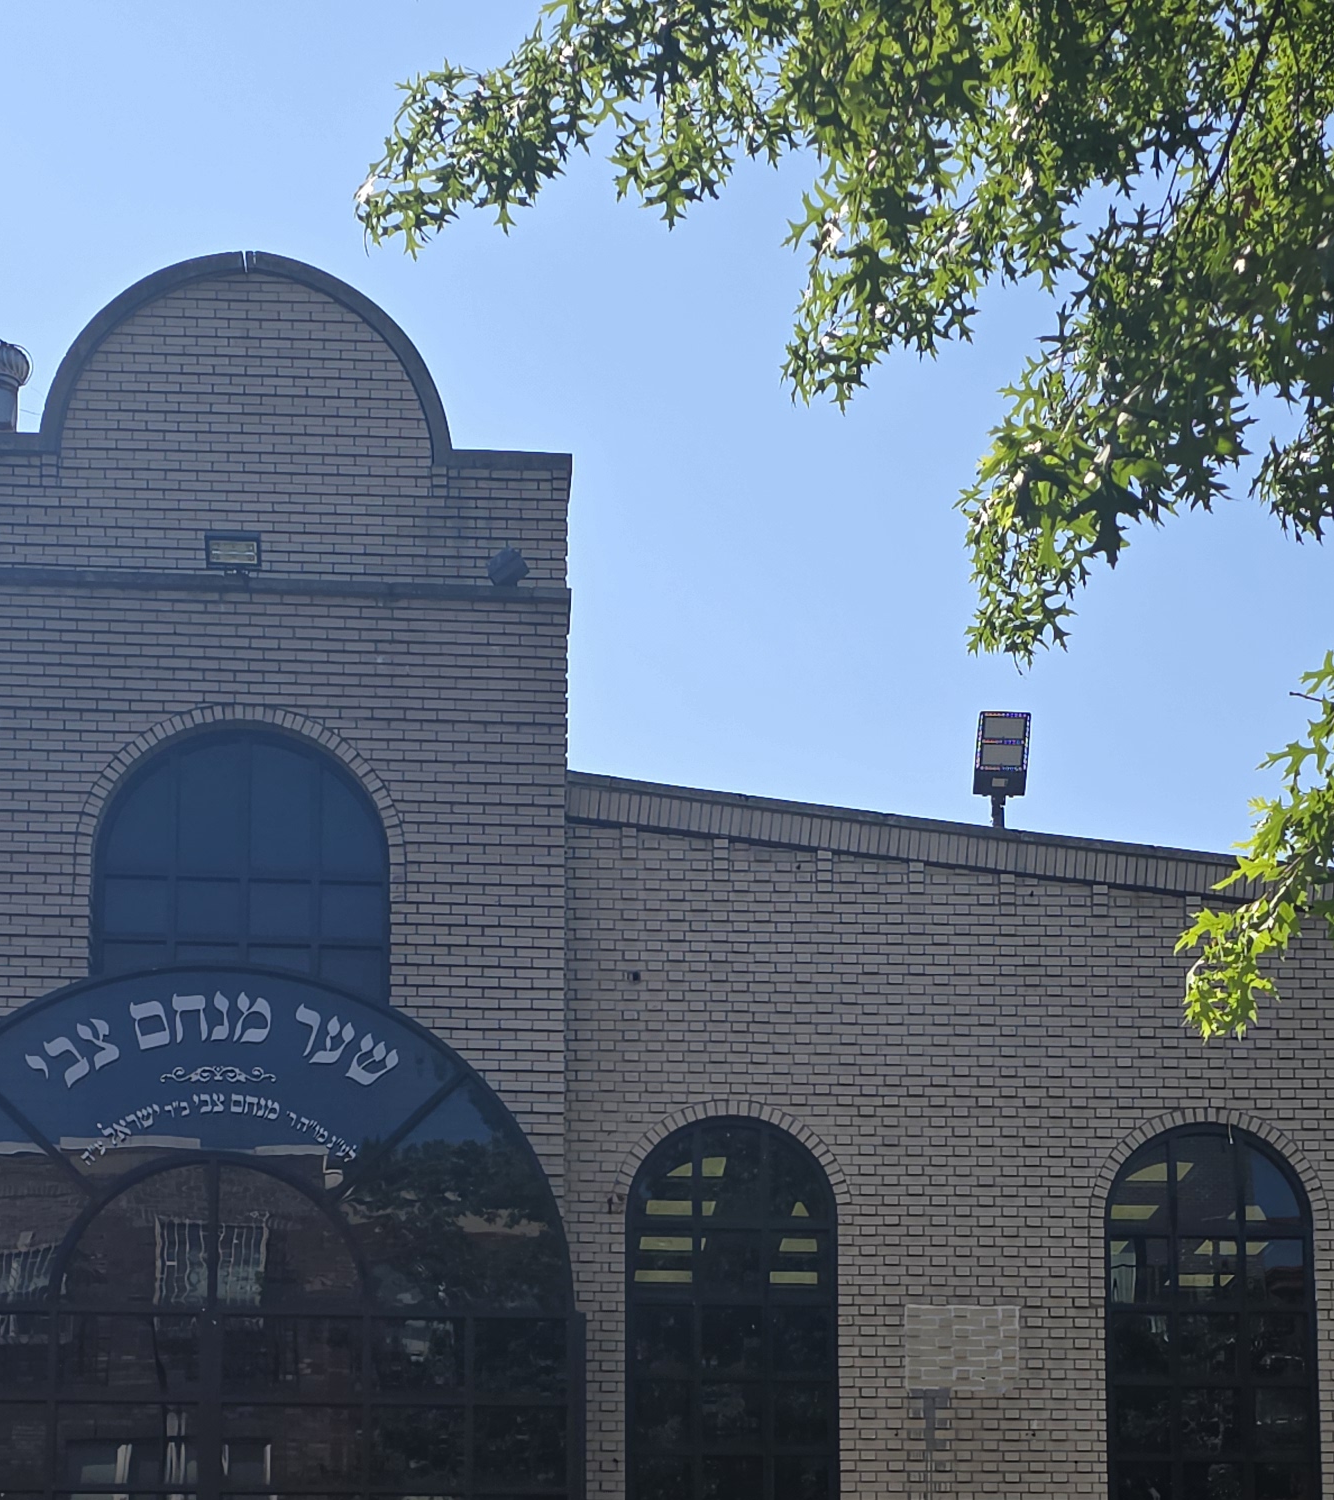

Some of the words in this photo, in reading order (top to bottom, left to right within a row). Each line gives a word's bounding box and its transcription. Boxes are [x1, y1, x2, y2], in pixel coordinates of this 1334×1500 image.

[130, 990, 271, 1050] מנחם
[296, 1003, 398, 1086] שער
[25, 1018, 120, 1088] צבי
[96, 1103, 160, 1145] ישראל
[192, 1092, 225, 1113] צבי
[230, 1093, 280, 1120] מנחם
